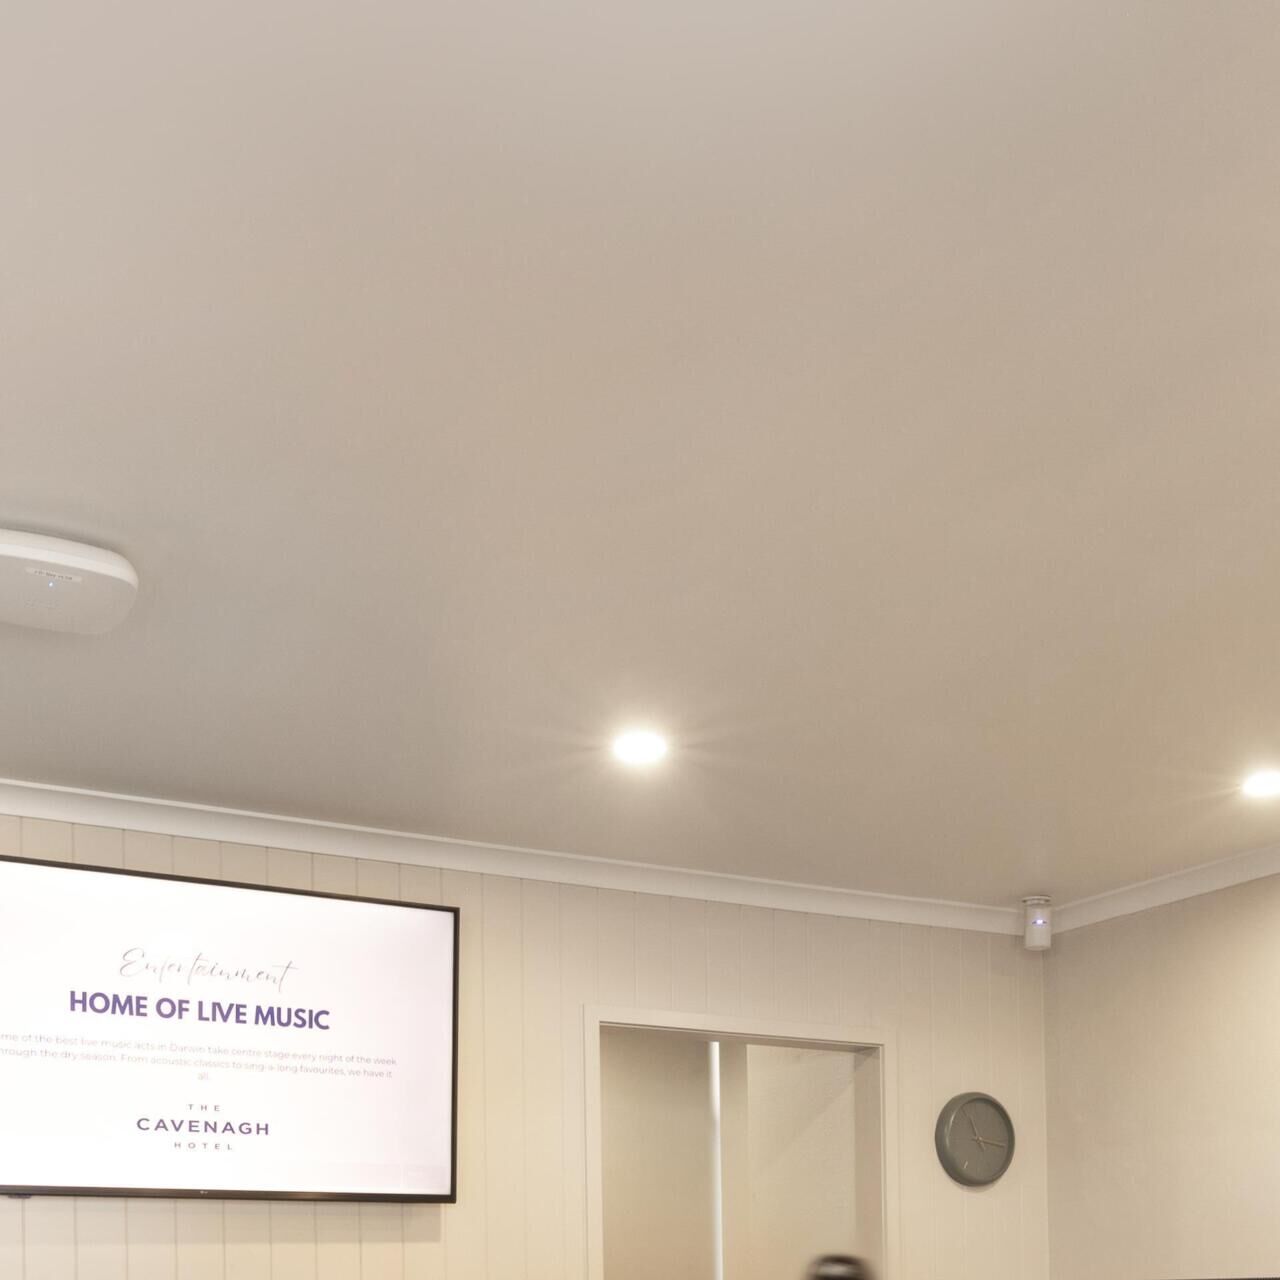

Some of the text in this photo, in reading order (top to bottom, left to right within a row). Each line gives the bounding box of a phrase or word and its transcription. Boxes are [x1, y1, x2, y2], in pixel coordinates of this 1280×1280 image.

[120, 947, 298, 992] Entertainment
[70, 990, 330, 1030] HOME OF LIVE MUSIC
[21, 1033, 32, 1043] of
[34, 1034, 51, 1044] the
[55, 1035, 78, 1046] best
[81, 1036, 98, 1047] live
[101, 1039, 131, 1050] music
[134, 1041, 155, 1051] acts
[157, 1042, 167, 1052] in
[169, 1043, 205, 1054] Darwin
[208, 1046, 228, 1056] take
[231, 1048, 261, 1057] centre
[264, 1050, 290, 1060] stage
[292, 1052, 317, 1062] every
[319, 1053, 343, 1063] night
[345, 1054, 355, 1063] of
[356, 1055, 371, 1064] the
[373, 1056, 397, 1066] week
[40, 1048, 57, 1059] the
[60, 1050, 77, 1062] dry
[120, 1054, 148, 1064] From
[150, 1056, 192, 1067] acoustic
[194, 1059, 230, 1069] classics
[232, 1060, 242, 1069] to
[300, 1064, 346, 1077] favourites,
[348, 1069, 361, 1077] we
[363, 1069, 384, 1079] have
[386, 1070, 392, 1079] it
[188, 1104, 221, 1112] THE
[136, 1117, 269, 1136] CAVENAGH
[174, 1141, 233, 1151] HOTEL
